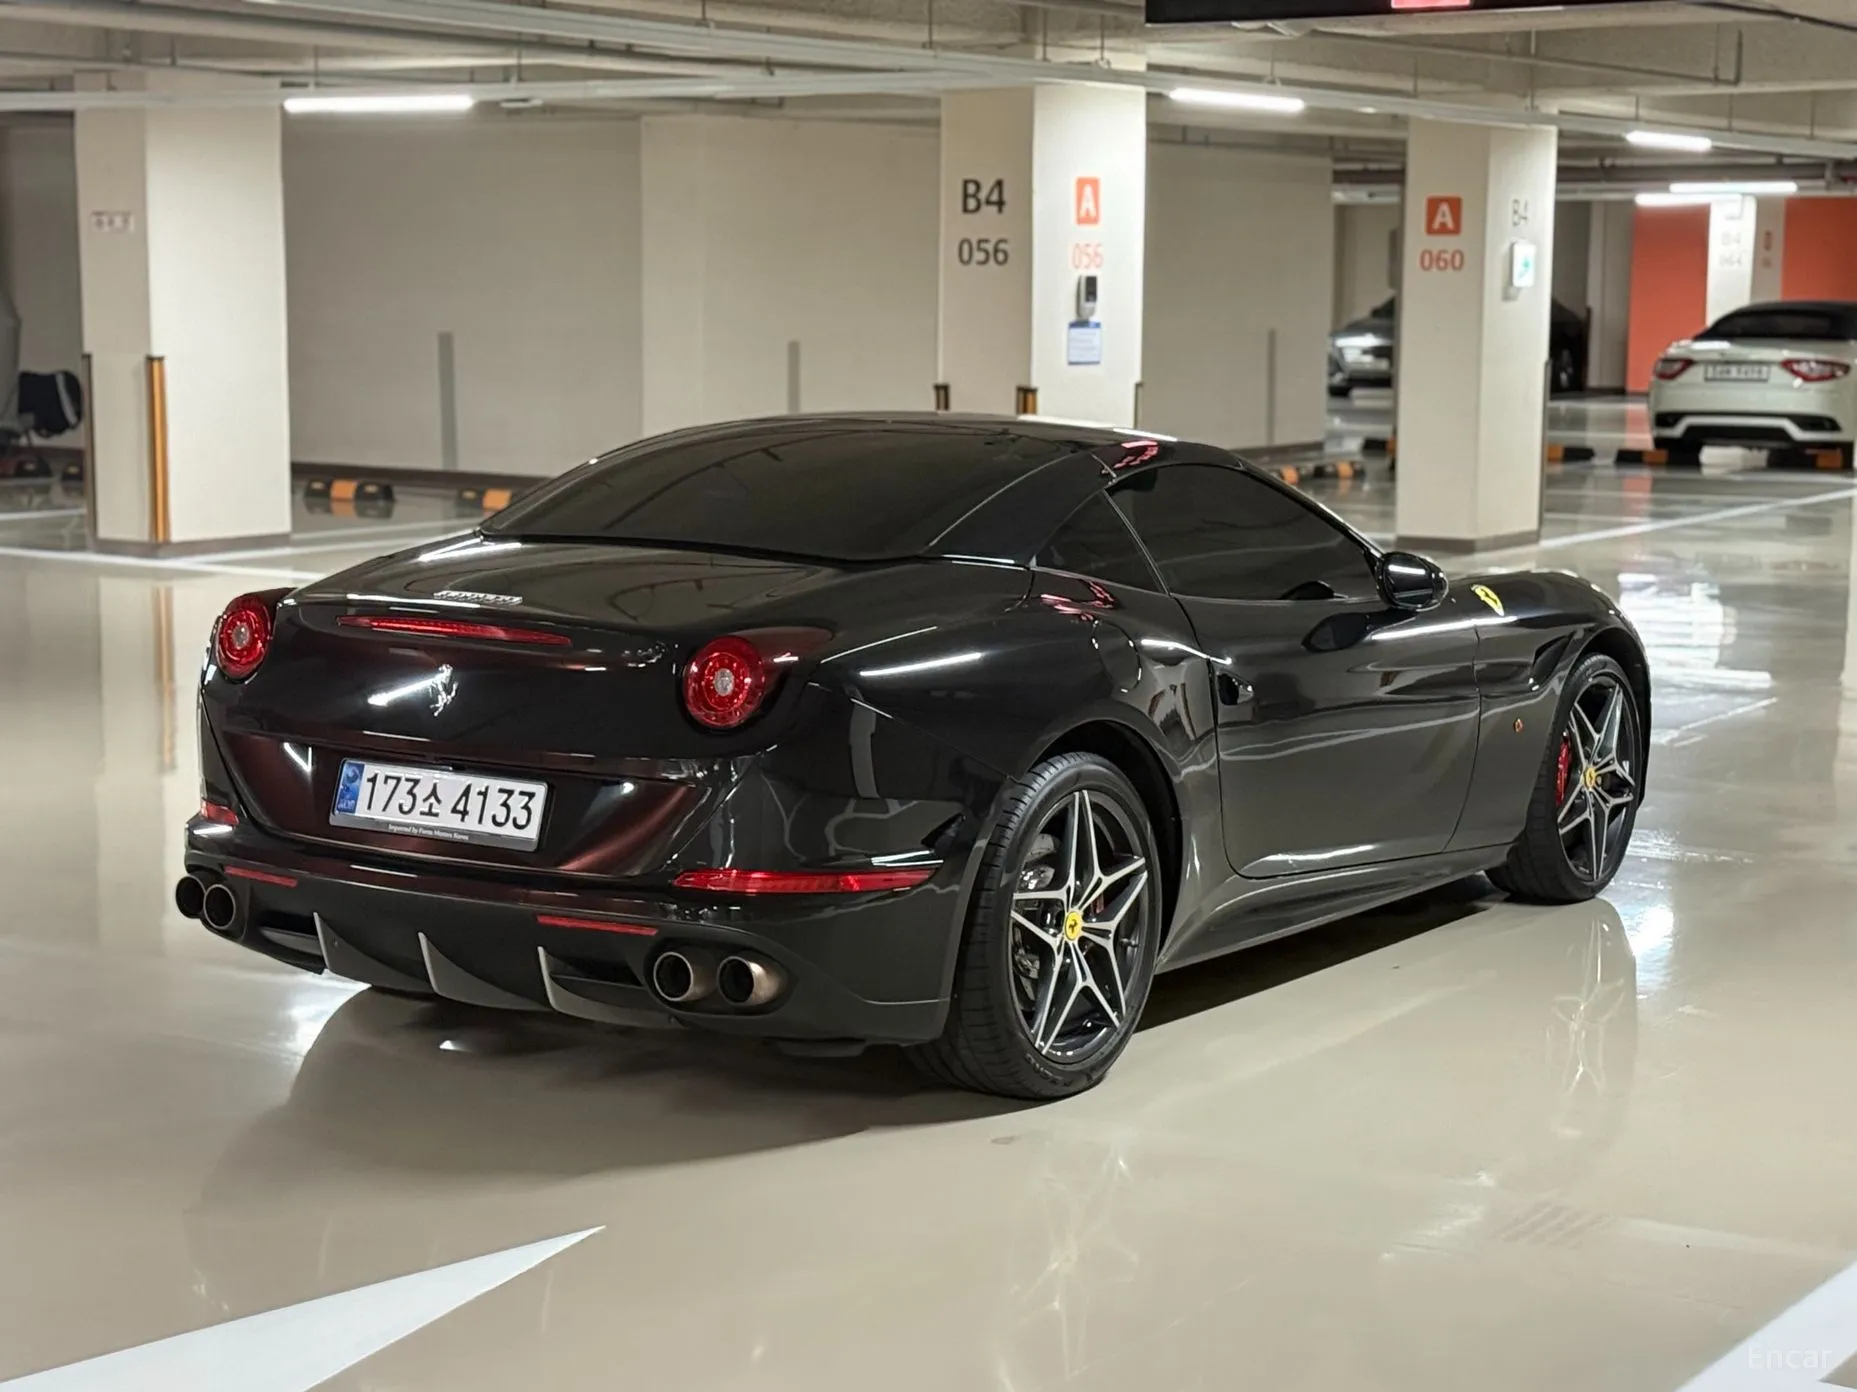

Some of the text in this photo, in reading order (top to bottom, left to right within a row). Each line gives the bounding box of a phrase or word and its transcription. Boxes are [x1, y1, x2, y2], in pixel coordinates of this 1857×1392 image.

[961, 178, 1007, 215] B4
[1079, 183, 1098, 217] A
[1431, 201, 1456, 231] A
[1512, 198, 1528, 227] B4
[957, 237, 1009, 267] 056
[1072, 242, 1103, 270] 056
[1419, 248, 1465, 272] 060
[366, 772, 537, 831] 173소 4133
